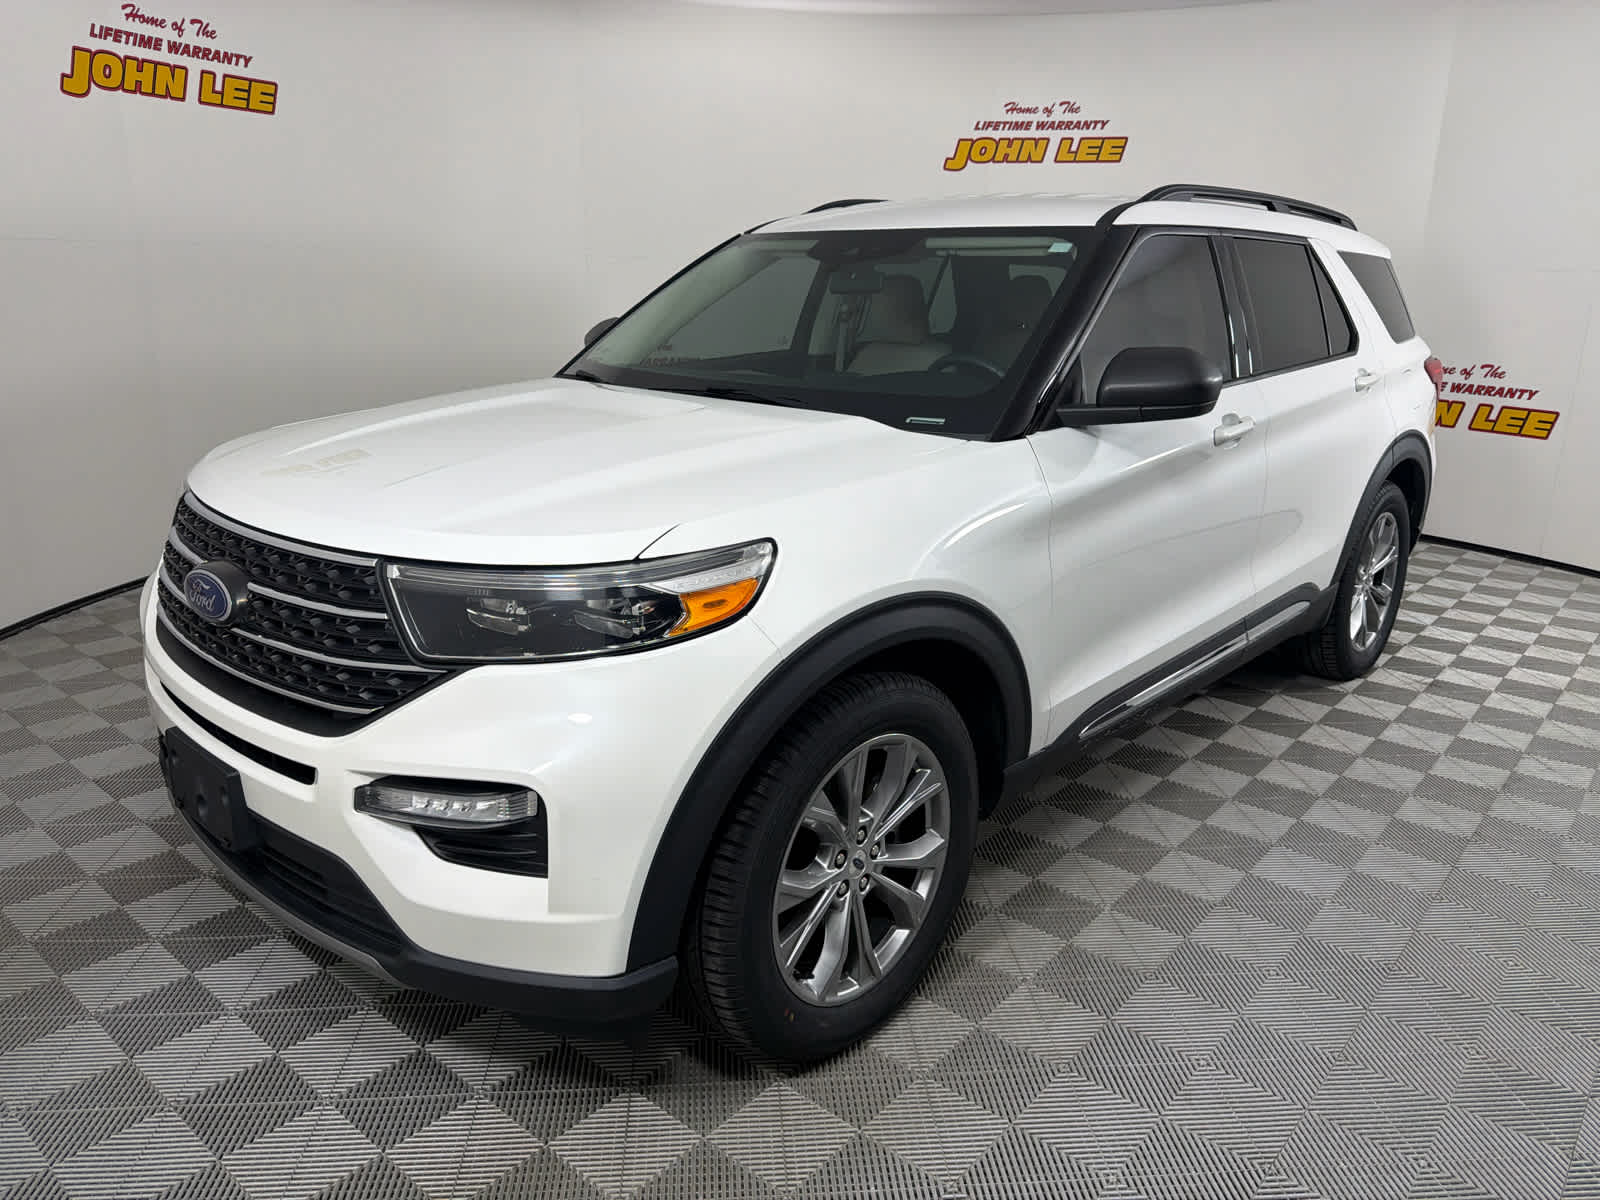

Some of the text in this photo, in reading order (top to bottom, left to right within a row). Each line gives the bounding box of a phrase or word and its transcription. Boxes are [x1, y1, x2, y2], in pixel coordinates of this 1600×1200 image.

[121, 3, 218, 40] Home of The
[89, 23, 253, 68] LIFETIME WARRANTY
[60, 46, 279, 116] JOHN LEE
[973, 119, 1111, 132] LIFETIME WARRANTY
[1003, 101, 1081, 118] Home of The
[943, 136, 1129, 172] JOHN LEE
[1460, 364, 1476, 380] of
[1480, 364, 1507, 379] The
[1450, 382, 1539, 400] WARRANTY
[1468, 403, 1560, 440] LEE
[189, 579, 216, 611] Ford
